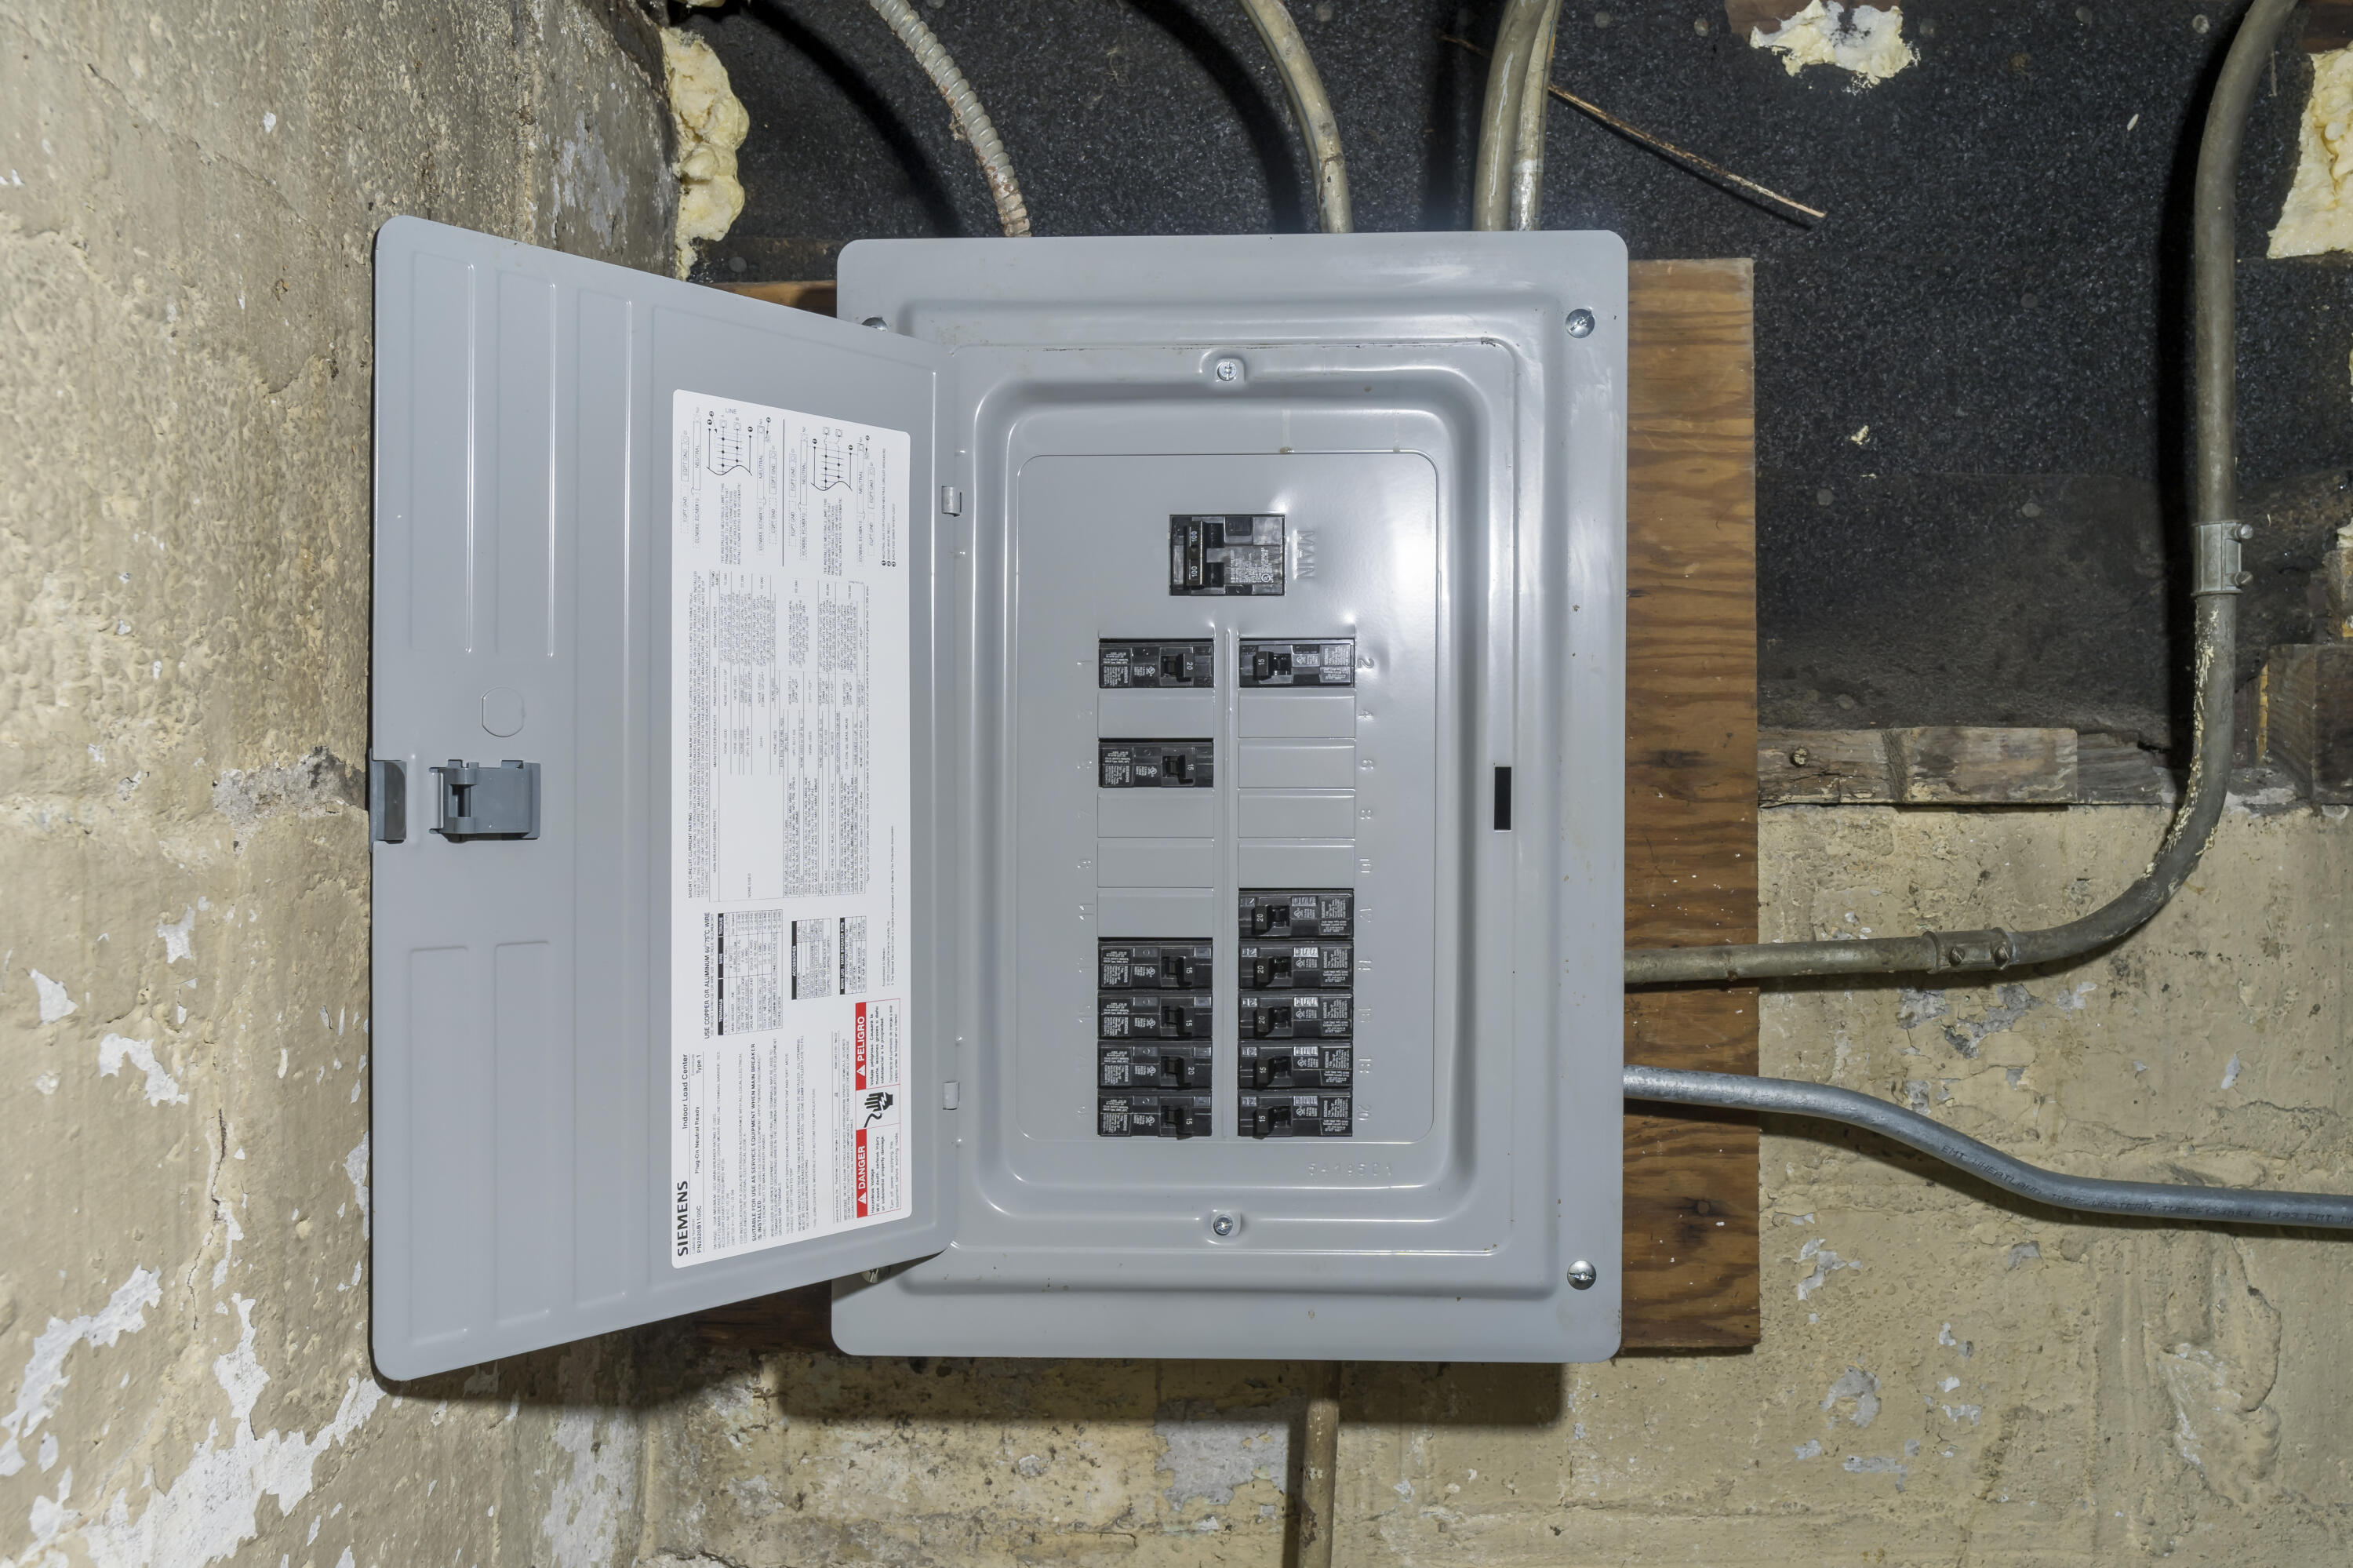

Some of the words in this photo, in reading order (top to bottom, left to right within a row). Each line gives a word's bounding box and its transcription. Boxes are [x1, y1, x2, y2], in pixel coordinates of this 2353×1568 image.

[1297, 530, 1316, 579] MAIN
[1186, 662, 1193, 671] 20
[1358, 659, 1374, 668] 2
[1257, 913, 1263, 922] 20
[1257, 965, 1264, 973] 20
[704, 989, 710, 998] OR
[1941, 1145, 1967, 1160] EMT
[1972, 1159, 2042, 1195] WHEATLAND
[2306, 1212, 2333, 1221] EMT
[678, 1181, 688, 1256] SIEMENS
